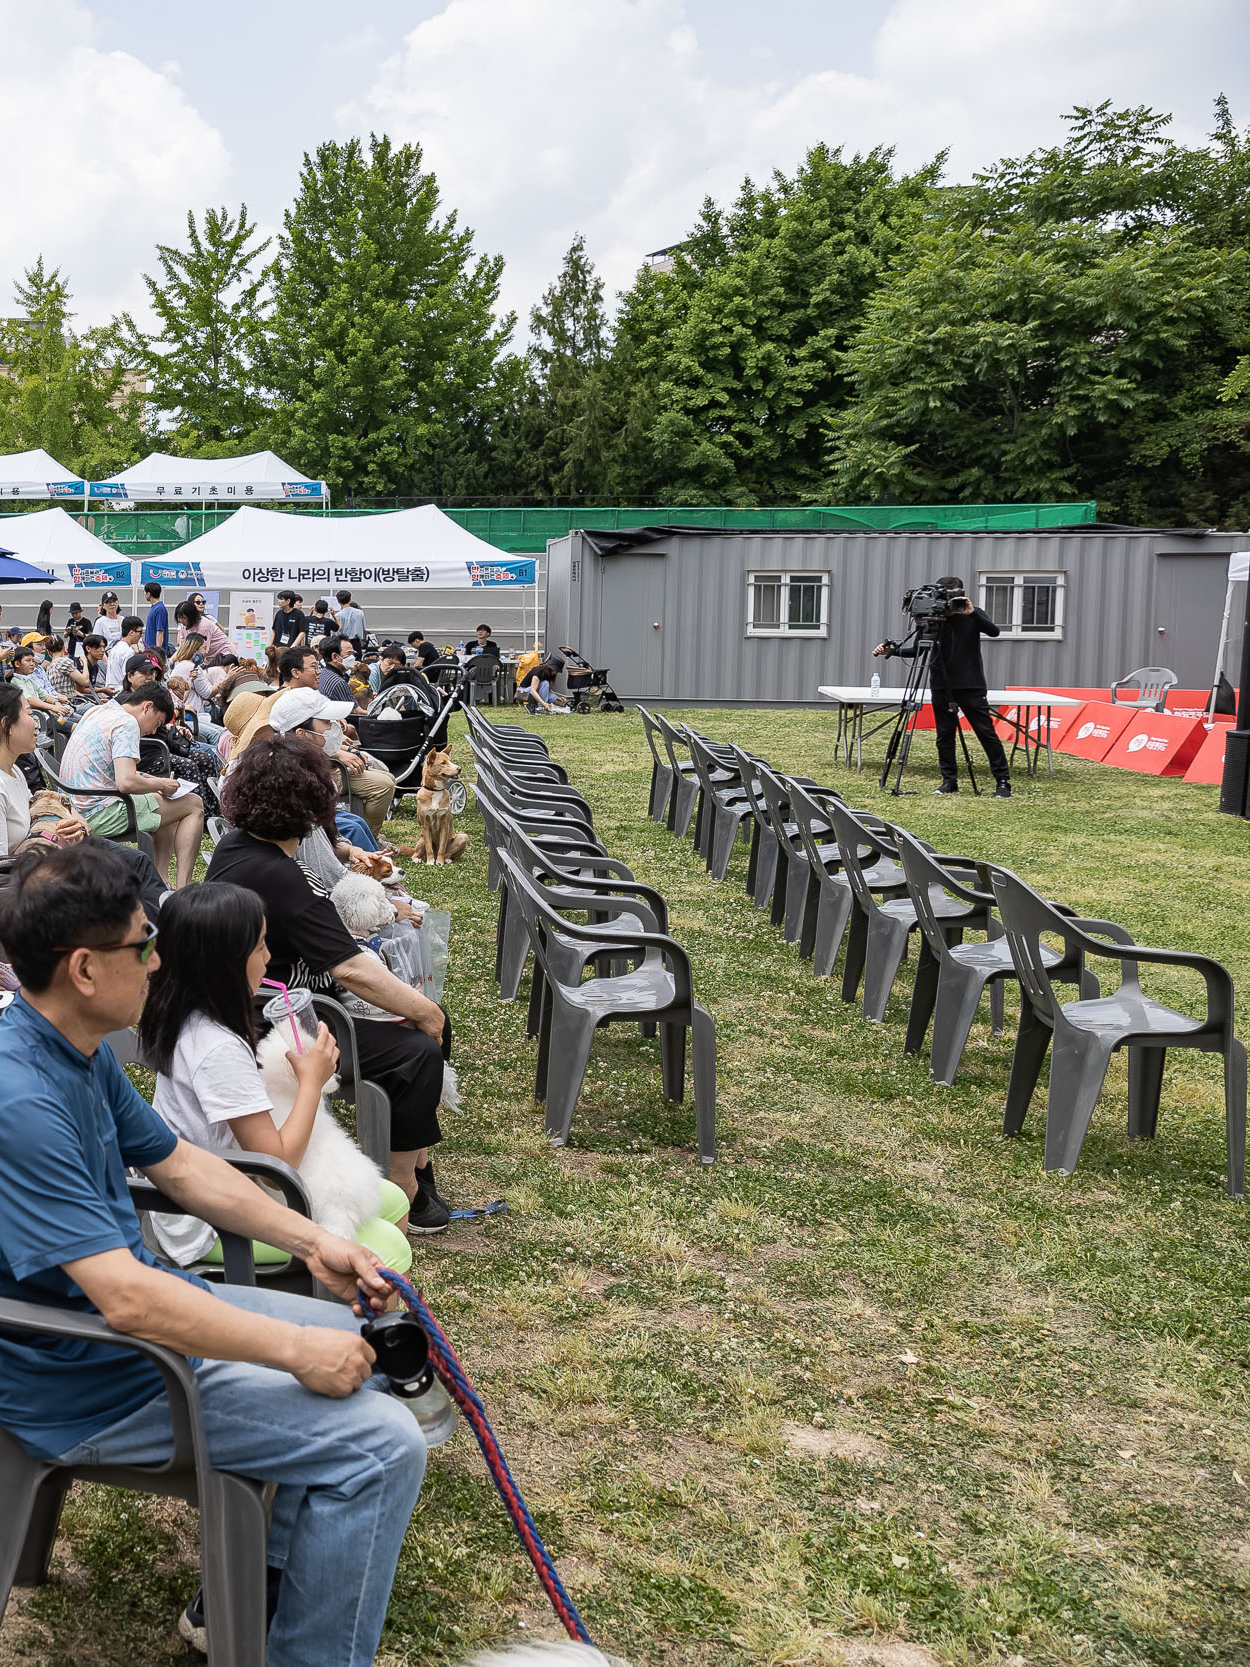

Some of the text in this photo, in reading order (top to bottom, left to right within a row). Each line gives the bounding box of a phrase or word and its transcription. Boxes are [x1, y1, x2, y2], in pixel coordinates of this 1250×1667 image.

[242, 566, 430, 583] 이상한 나라의 반함이(방탈출)
